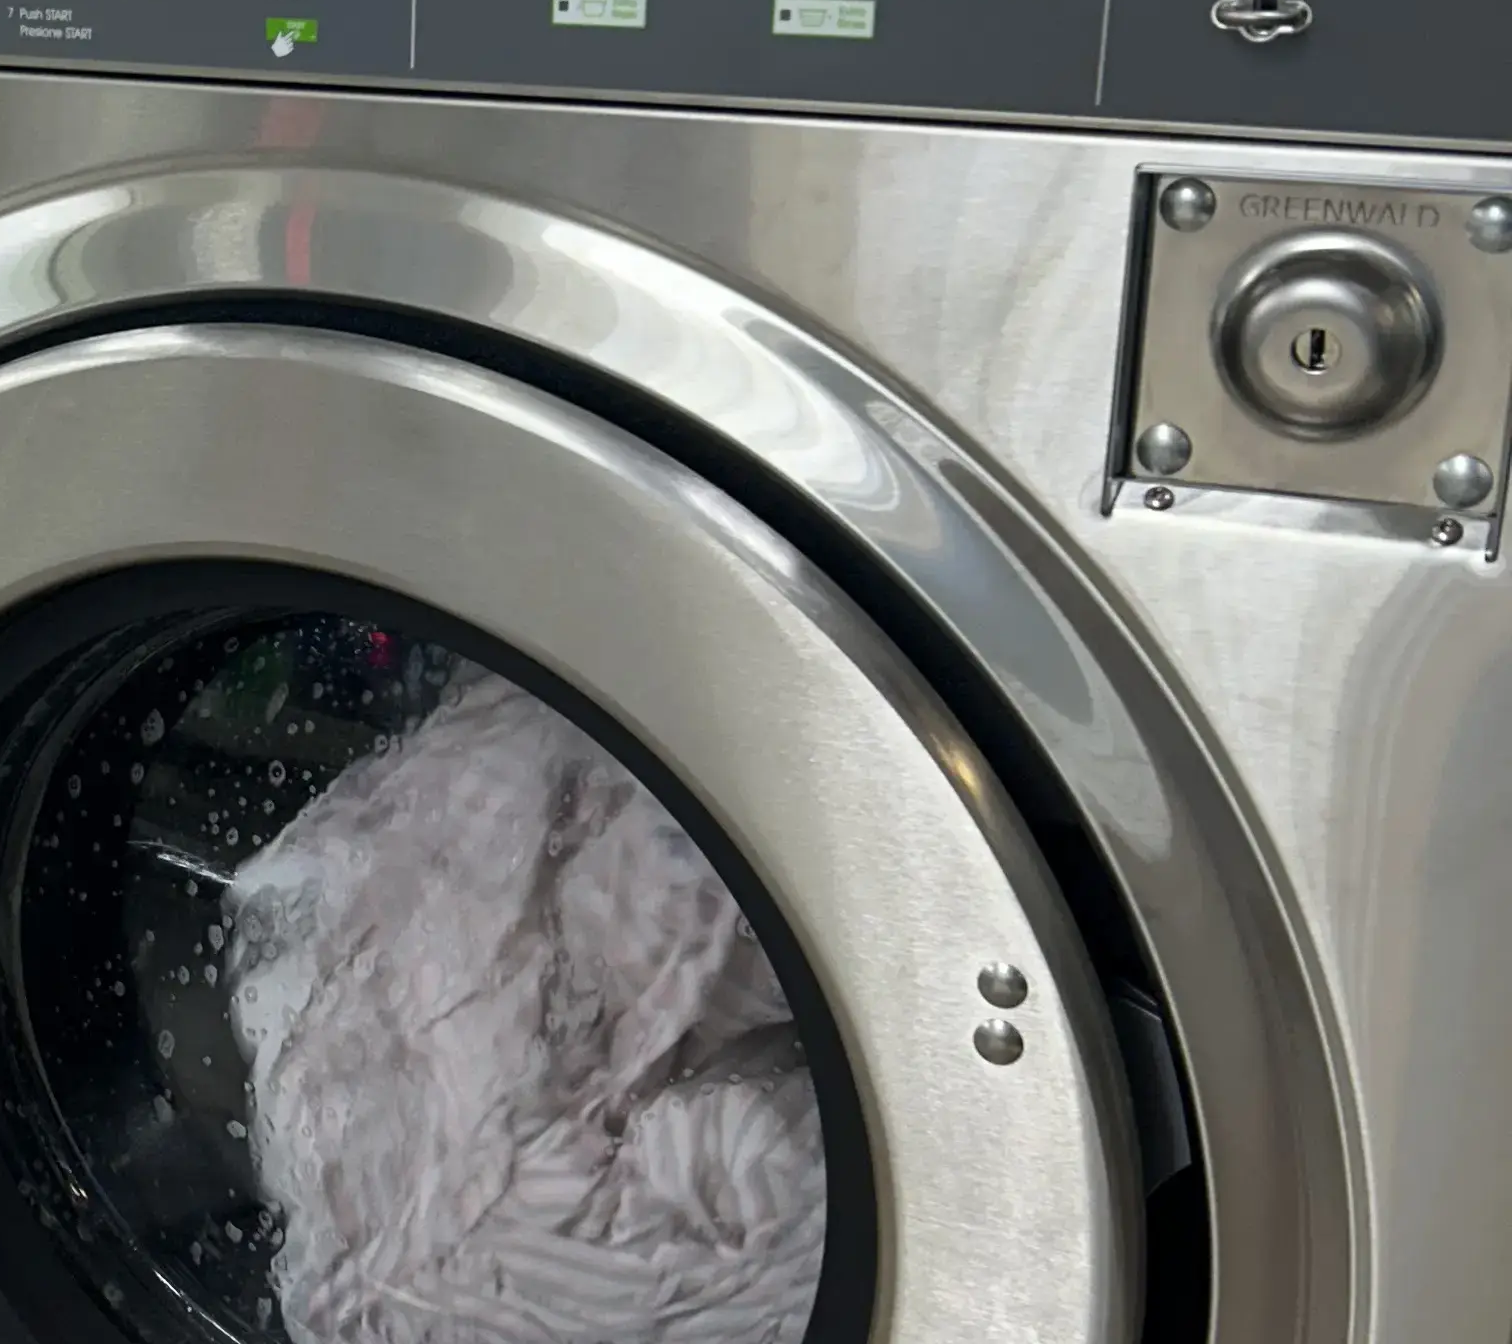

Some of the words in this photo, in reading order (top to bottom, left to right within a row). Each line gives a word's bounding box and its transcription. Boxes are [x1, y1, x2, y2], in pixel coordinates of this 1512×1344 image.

[7, 7, 14, 19] 7
[19, 7, 44, 21] Push
[45, 8, 73, 22] START
[19, 24, 63, 39] Presione
[65, 26, 93, 40] START
